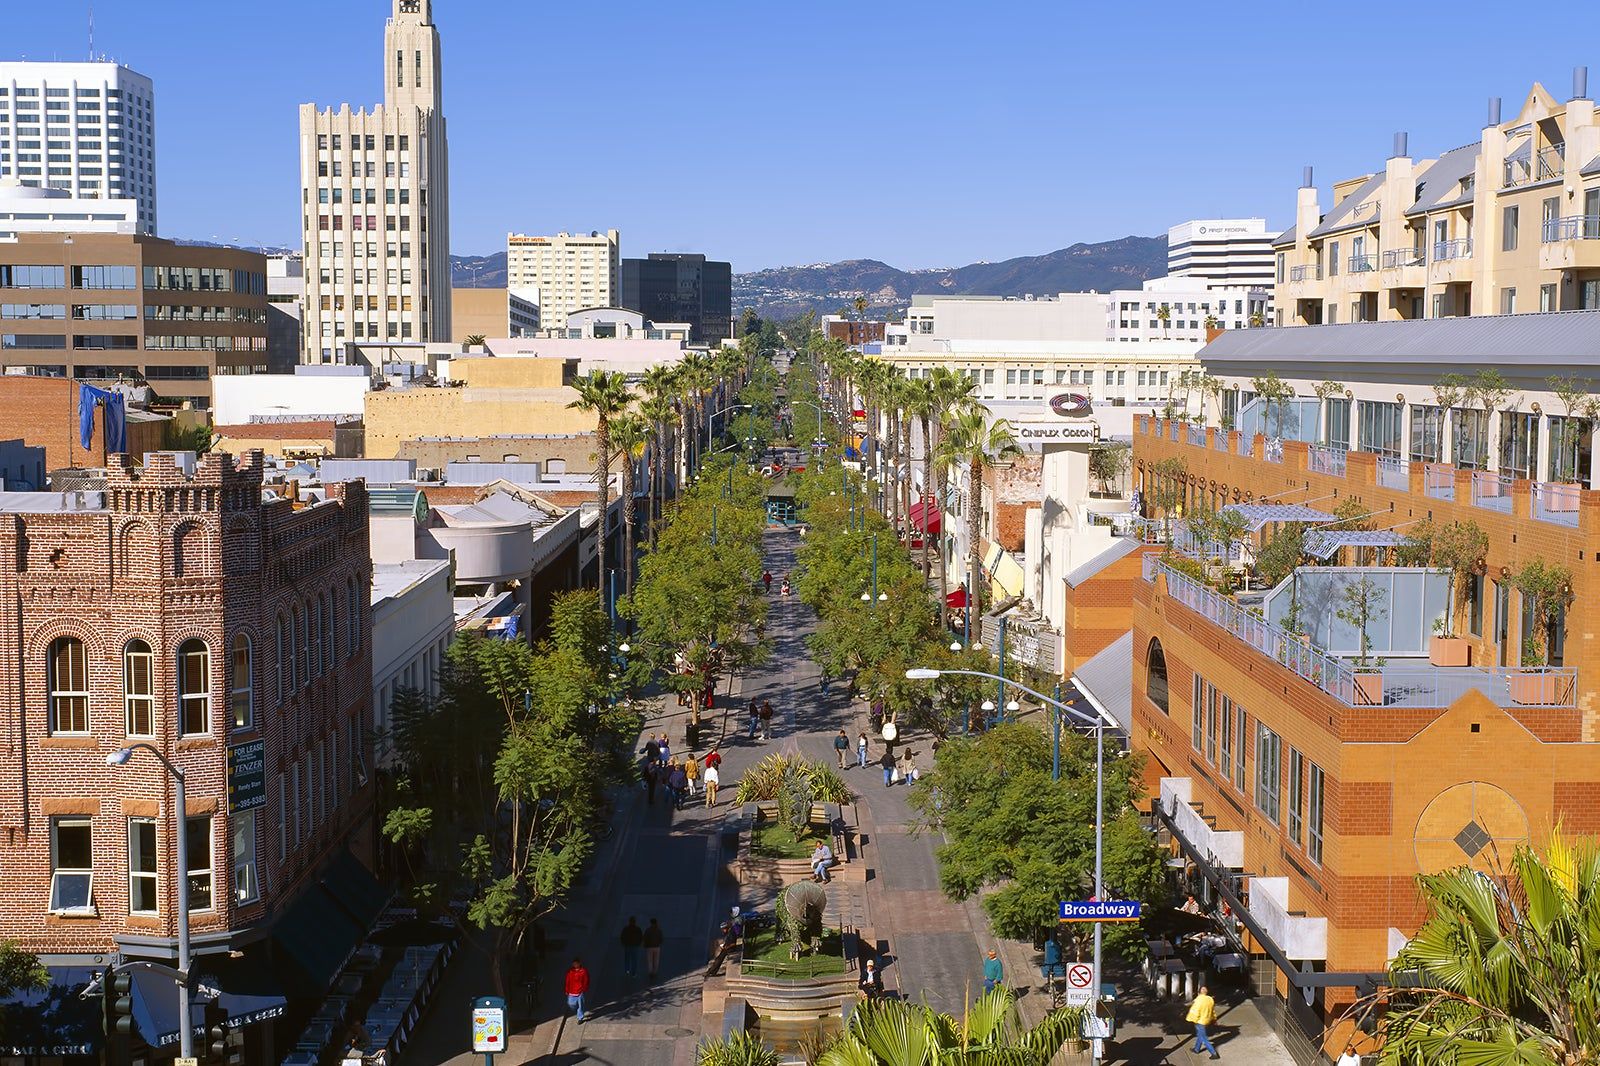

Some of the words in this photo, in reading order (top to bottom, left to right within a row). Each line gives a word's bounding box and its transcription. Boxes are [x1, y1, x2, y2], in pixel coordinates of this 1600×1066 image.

[1021, 428, 1060, 438] CINEPLEX
[1062, 427, 1094, 438] ODEON
[234, 748, 246, 756] FOR
[246, 743, 264, 753] LEASE
[235, 760, 263, 773] TENZER
[1064, 903, 1135, 917] Broadway
